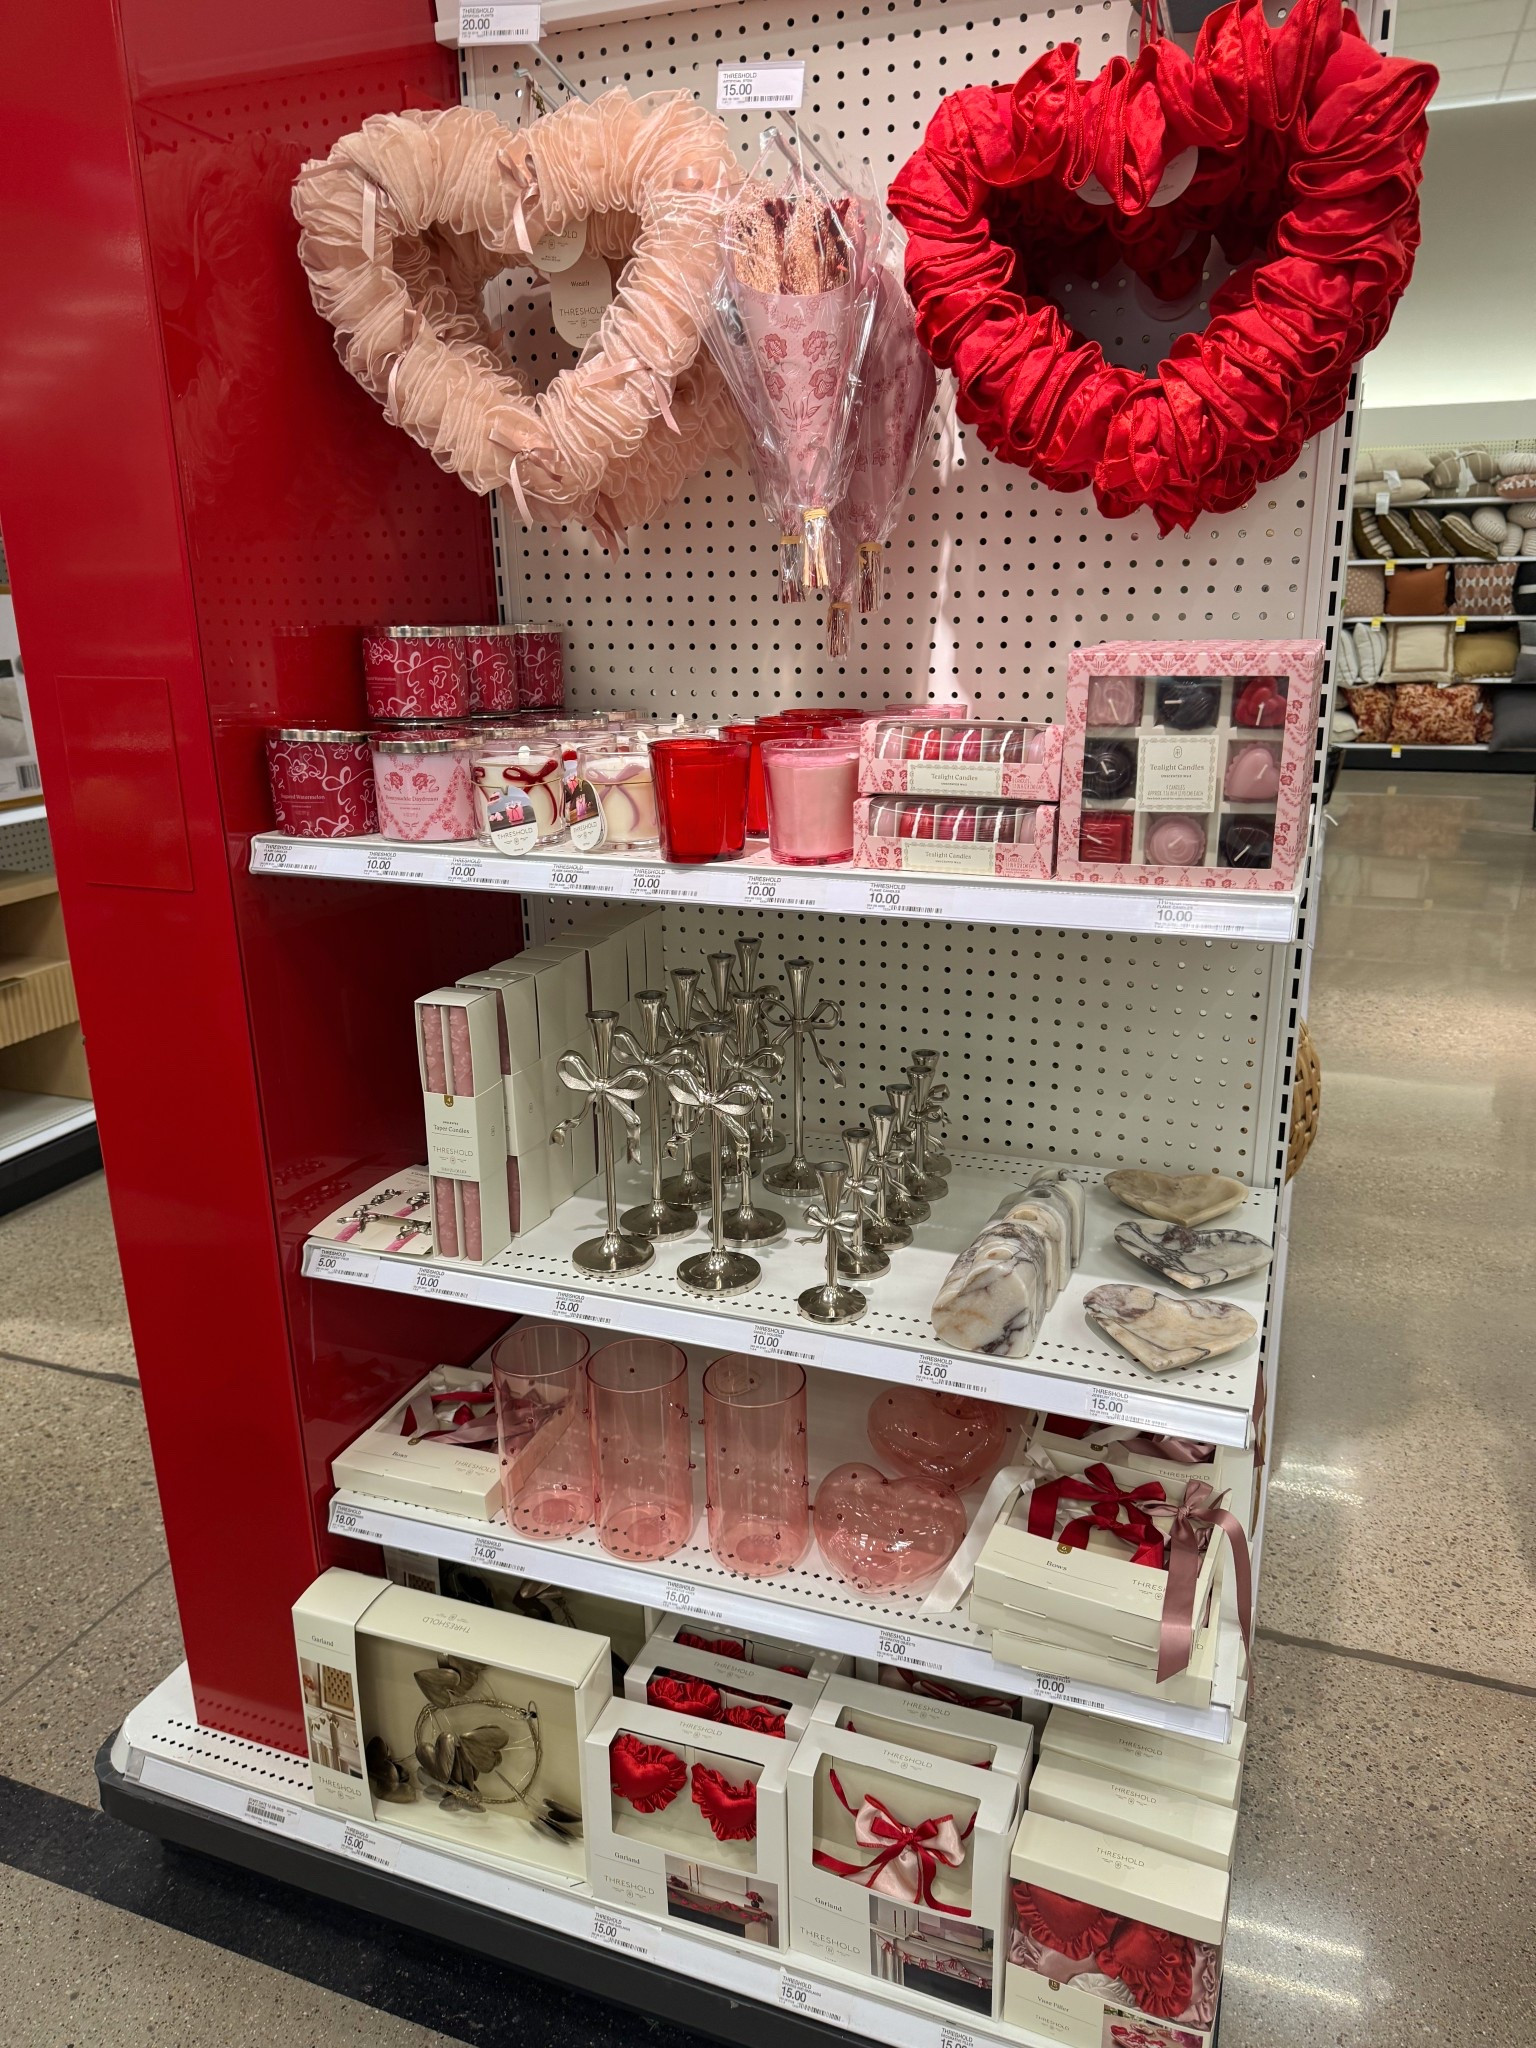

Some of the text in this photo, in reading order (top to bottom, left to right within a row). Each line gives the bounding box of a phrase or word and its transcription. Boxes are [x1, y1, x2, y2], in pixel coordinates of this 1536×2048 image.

[462, 18, 490, 30] 20.00
[724, 84, 752, 96] 15.00
[560, 306, 606, 317] THRESHOLD
[931, 773, 954, 781] Tealight
[573, 821, 598, 832] THRESHOLD
[497, 827, 533, 840] THRESHOLD
[264, 853, 286, 862] 10.00
[925, 851, 948, 859] Tealight
[368, 860, 391, 870] 10.00
[451, 867, 476, 876] 10.00
[552, 873, 578, 883] 10.00
[634, 878, 660, 888] 10.00
[748, 886, 776, 896] 10.00
[870, 893, 900, 904] 10.00
[1158, 909, 1192, 922] 10.00
[448, 1126, 470, 1134] Candles
[433, 1146, 474, 1157] THRESHOLD
[318, 1258, 336, 1268] 5.00
[420, 1268, 445, 1276] THRESHOLD
[416, 1276, 439, 1287] 10.00
[558, 1292, 585, 1300] THRESHOLD
[556, 1301, 579, 1312] 15.00
[754, 1325, 785, 1334] THRESHOLD
[754, 1334, 779, 1348] 10.00
[920, 1354, 952, 1365] THRESHOLD
[919, 1364, 947, 1378] 15.00
[1093, 1388, 1129, 1399] THRESHOLD
[1092, 1398, 1123, 1413] 15.00
[454, 1459, 496, 1474] THRESHOLD
[1159, 1470, 1210, 1481] THRESHOLD
[337, 1505, 361, 1515] THRESHOLD
[335, 1514, 356, 1526] 18.00
[476, 1538, 502, 1547] THRESHOLD
[474, 1546, 496, 1560] 14.00
[1046, 1560, 1067, 1571] Bows
[667, 1581, 695, 1591] THRESHOLD
[666, 1590, 690, 1604] 15.00
[422, 1616, 471, 1634] THRESHOLD
[311, 1635, 334, 1647] Garland
[880, 1630, 911, 1642] THRESHOLD
[880, 1640, 906, 1655] 15.00
[714, 1661, 755, 1677] THRESHOLD
[1036, 1677, 1064, 1693] 10.00
[902, 1699, 951, 1717] THRESHOLD
[679, 1720, 723, 1736] THRESHOLD
[1118, 1738, 1163, 1756] THRESHOLD
[883, 1749, 933, 1769] THRESHOLD
[318, 1776, 362, 1797] THRESHOLD
[1110, 1784, 1157, 1804] THRESHOLD
[346, 1826, 369, 1838] THRESHOLD
[344, 1835, 364, 1850] 15.00
[614, 1851, 640, 1865] Garland
[1096, 1846, 1145, 1868] THRESHOLD
[604, 1874, 655, 1895] THRESHOLD
[814, 1896, 842, 1912] Garland
[595, 1912, 622, 1925] THRESHOLD
[594, 1922, 617, 1937] 15.00
[799, 1926, 861, 1955] THRESHOLD
[783, 1976, 812, 1990] THRESHOLD
[782, 1986, 806, 2003] 15.00
[1037, 1996, 1069, 2012] Vase Filler
[1034, 2014, 1070, 2031] THRESHOLD
[942, 2027, 973, 2043] THRESHOLD
